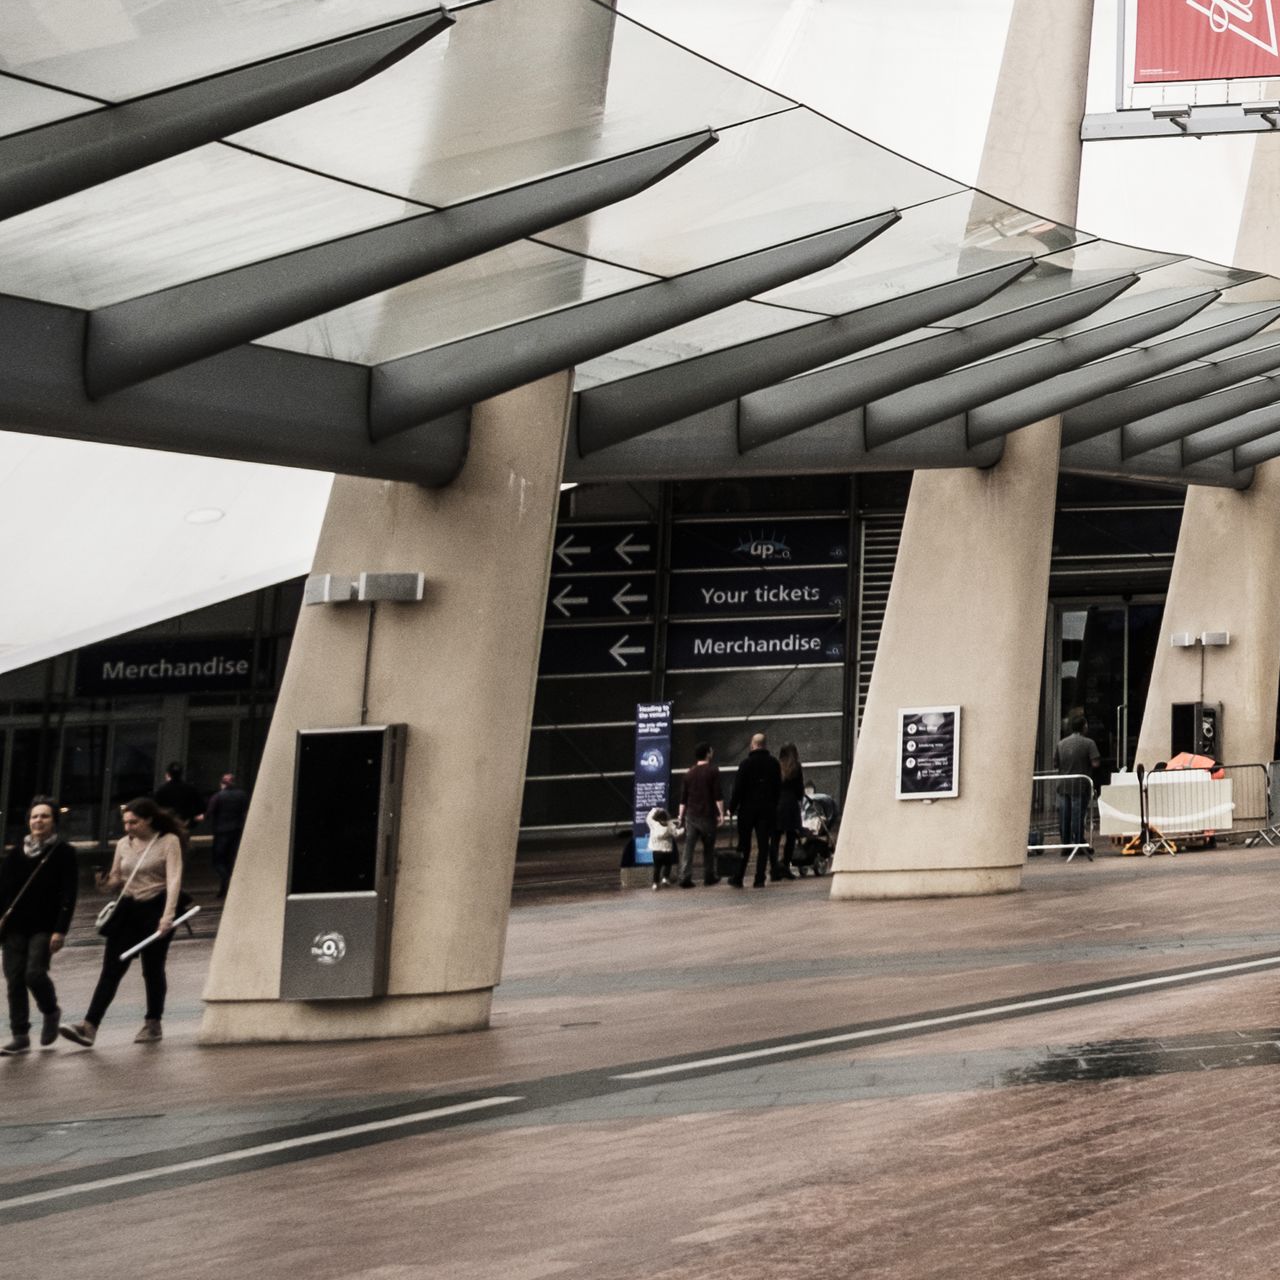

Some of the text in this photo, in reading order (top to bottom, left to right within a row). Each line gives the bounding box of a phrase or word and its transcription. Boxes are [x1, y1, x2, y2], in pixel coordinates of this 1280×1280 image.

[701, 586, 749, 605] Your
[754, 584, 821, 603] tickets
[693, 634, 822, 655] Merchandise
[102, 656, 249, 681] Merchandise
